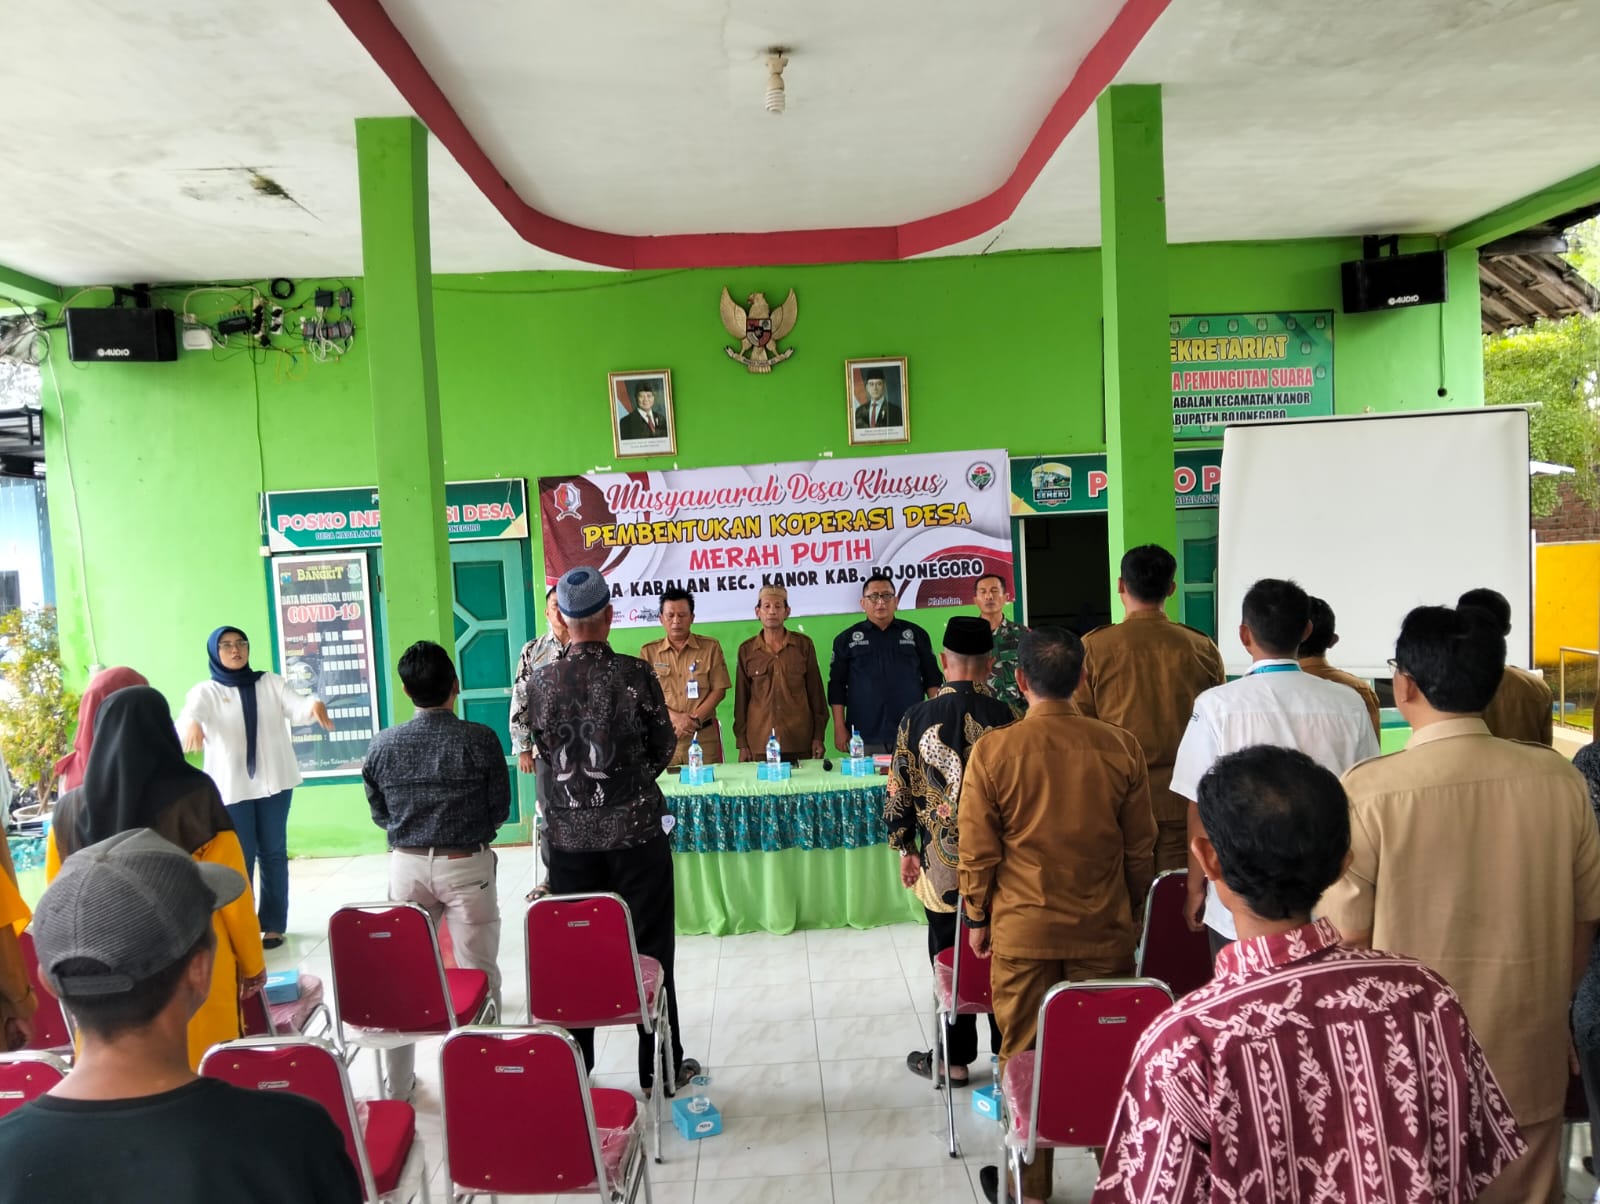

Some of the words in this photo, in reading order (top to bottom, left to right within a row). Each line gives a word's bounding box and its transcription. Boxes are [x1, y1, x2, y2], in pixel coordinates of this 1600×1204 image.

[1171, 335, 1288, 362] EKRETARIAT
[1184, 369, 1269, 391] PEMUNGUTAN
[1271, 367, 1314, 387] SUARA
[1173, 395, 1212, 408] ABALAN
[1215, 392, 1274, 407] KECAMATAN
[1276, 391, 1311, 405] KANOR
[1173, 412, 1219, 426] BUPATEN
[606, 474, 781, 516] Musyawarah
[787, 474, 846, 500] Desa
[853, 468, 944, 498] Khusus
[277, 512, 346, 532] POSKO
[463, 502, 516, 523] DESA
[583, 514, 761, 549] PEMBENTUKAN
[769, 506, 894, 537] KOPERASI
[903, 502, 972, 528] DESA
[689, 544, 781, 571] MERAH
[790, 538, 873, 565] PUTIH
[297, 565, 344, 581] BANGKIT
[630, 577, 710, 597] KABALAN
[717, 575, 755, 591] KEC.
[762, 570, 817, 588] KANOR
[825, 568, 866, 584] KAB.
[871, 559, 984, 580] BOJONEGORO
[281, 594, 299, 605] DATA
[300, 591, 341, 604] MENINGGAL
[341, 590, 363, 602] DUNIA
[287, 603, 361, 623] COVID-19
